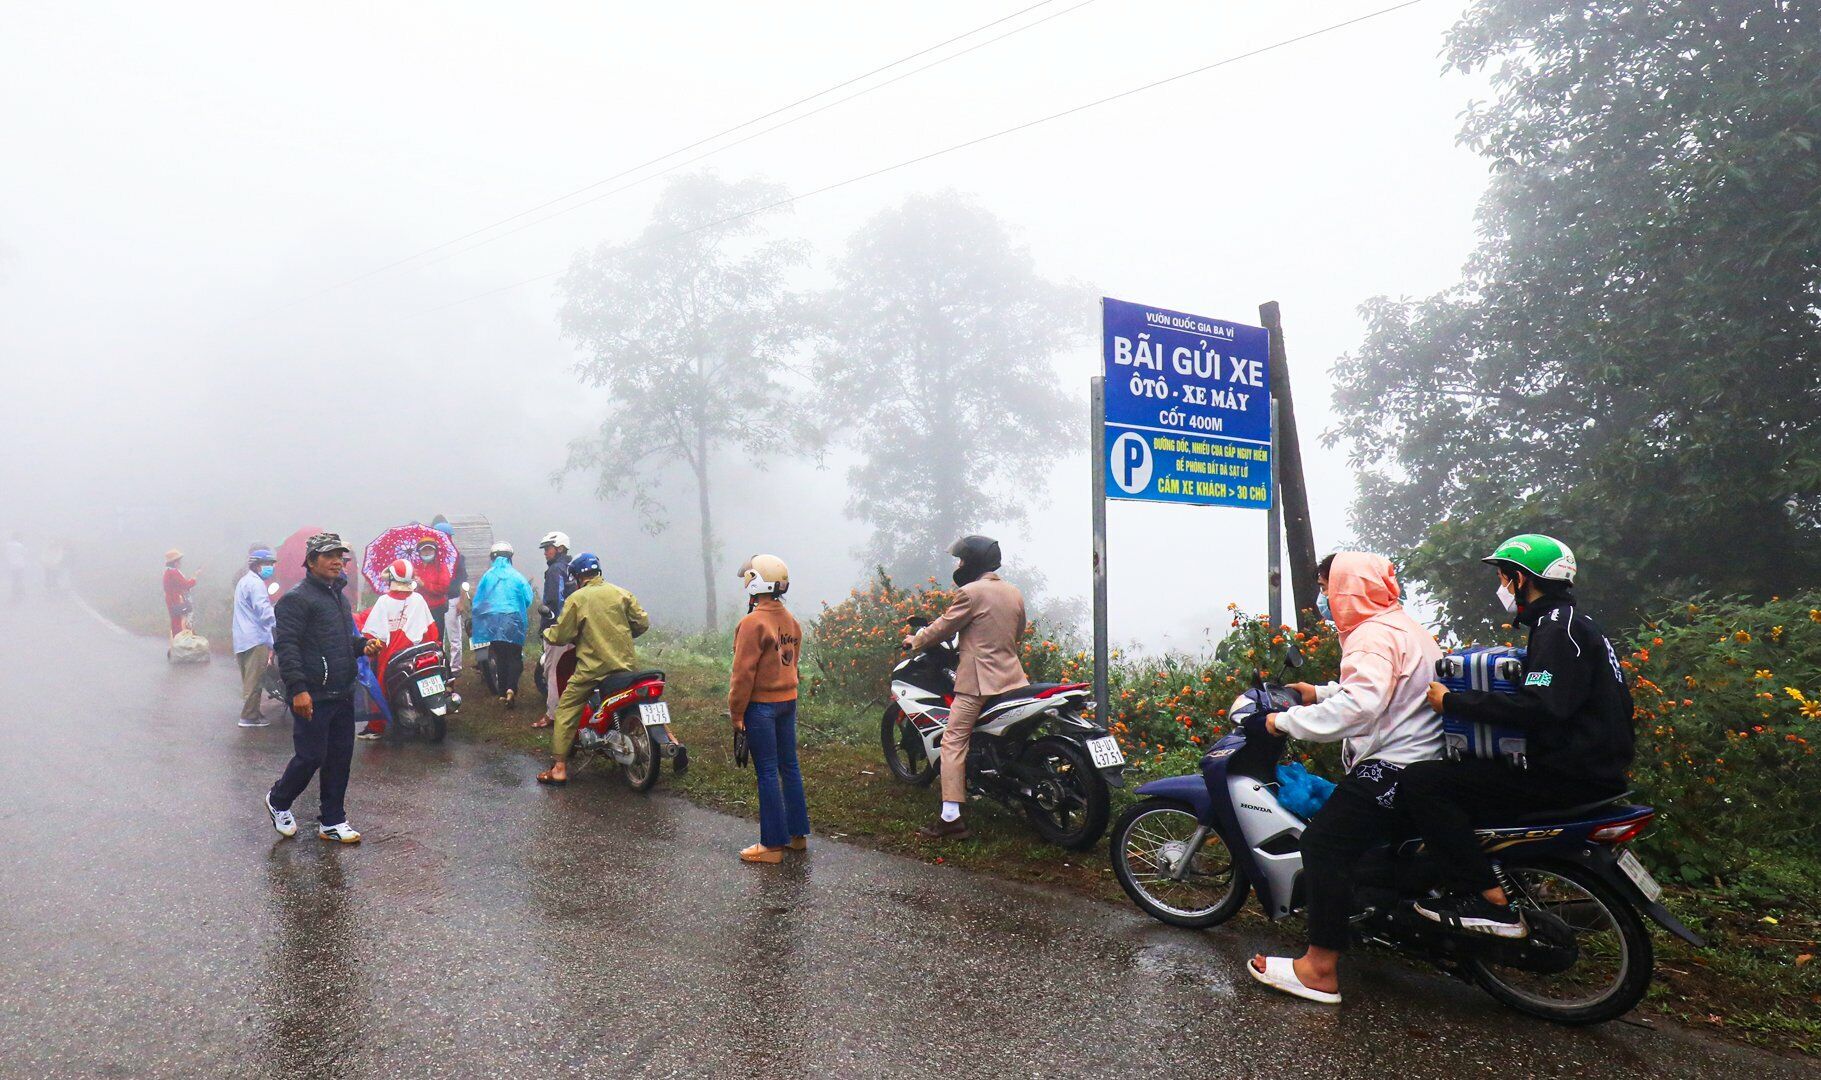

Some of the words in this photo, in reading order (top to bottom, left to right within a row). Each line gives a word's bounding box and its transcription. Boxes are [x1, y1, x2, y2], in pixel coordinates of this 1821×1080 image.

[1172, 317, 1196, 330] QUỐC
[1198, 323, 1211, 333] GIA
[1213, 326, 1224, 335] BA
[1114, 332, 1163, 371] BÃI
[1172, 340, 1220, 380] GỬI
[1229, 356, 1263, 388] XE
[1130, 371, 1168, 399] ÔTÔ
[1182, 385, 1207, 405] XE
[1211, 387, 1250, 411] MÁY
[1159, 406, 1186, 426] CỐT
[1189, 415, 1223, 431] 400M
[1124, 438, 1144, 487] P
[1157, 473, 1179, 494] CẤM
[1182, 480, 1194, 495] XE
[1196, 479, 1226, 498] KHÁCH
[1240, 803, 1273, 814] HONDA
